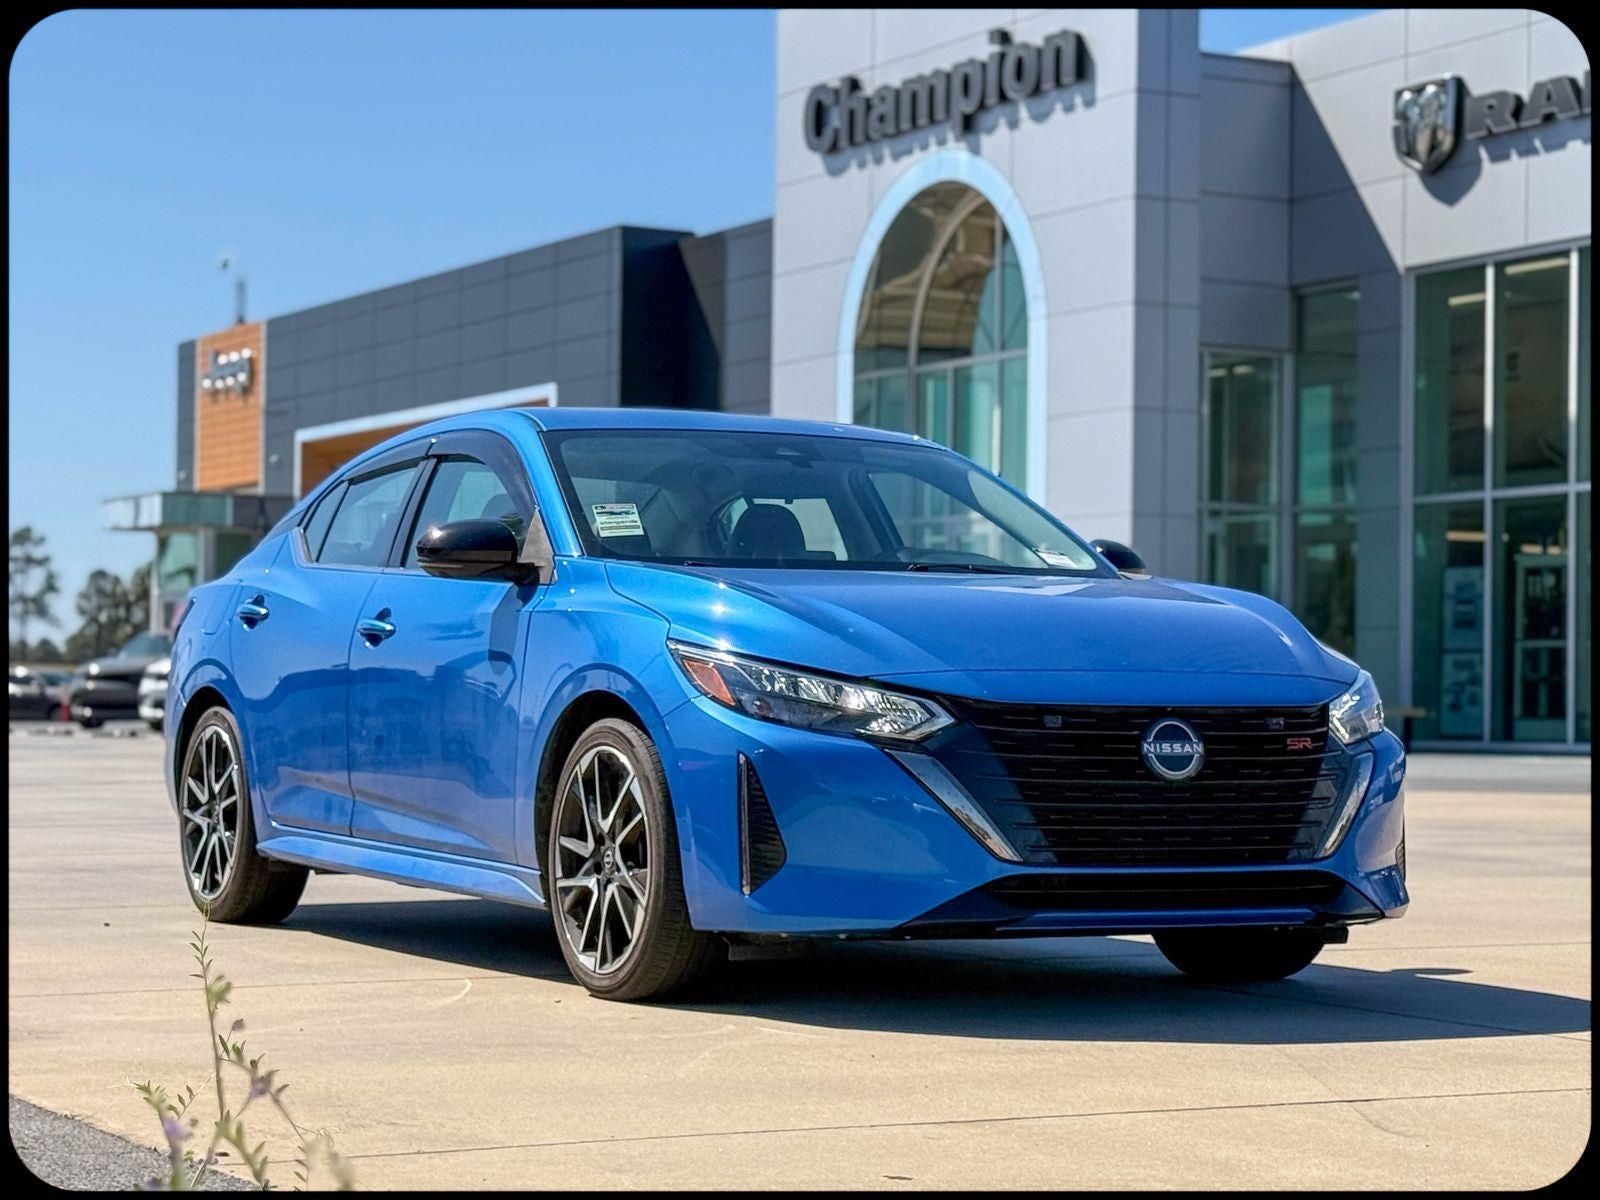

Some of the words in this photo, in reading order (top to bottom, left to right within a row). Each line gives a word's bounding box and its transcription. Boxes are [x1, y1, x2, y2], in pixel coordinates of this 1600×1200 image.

[804, 27, 1093, 154] Champion
[1465, 70, 1591, 140] RA
[1143, 743, 1202, 753] NISSAN
[1286, 737, 1312, 750] SR
